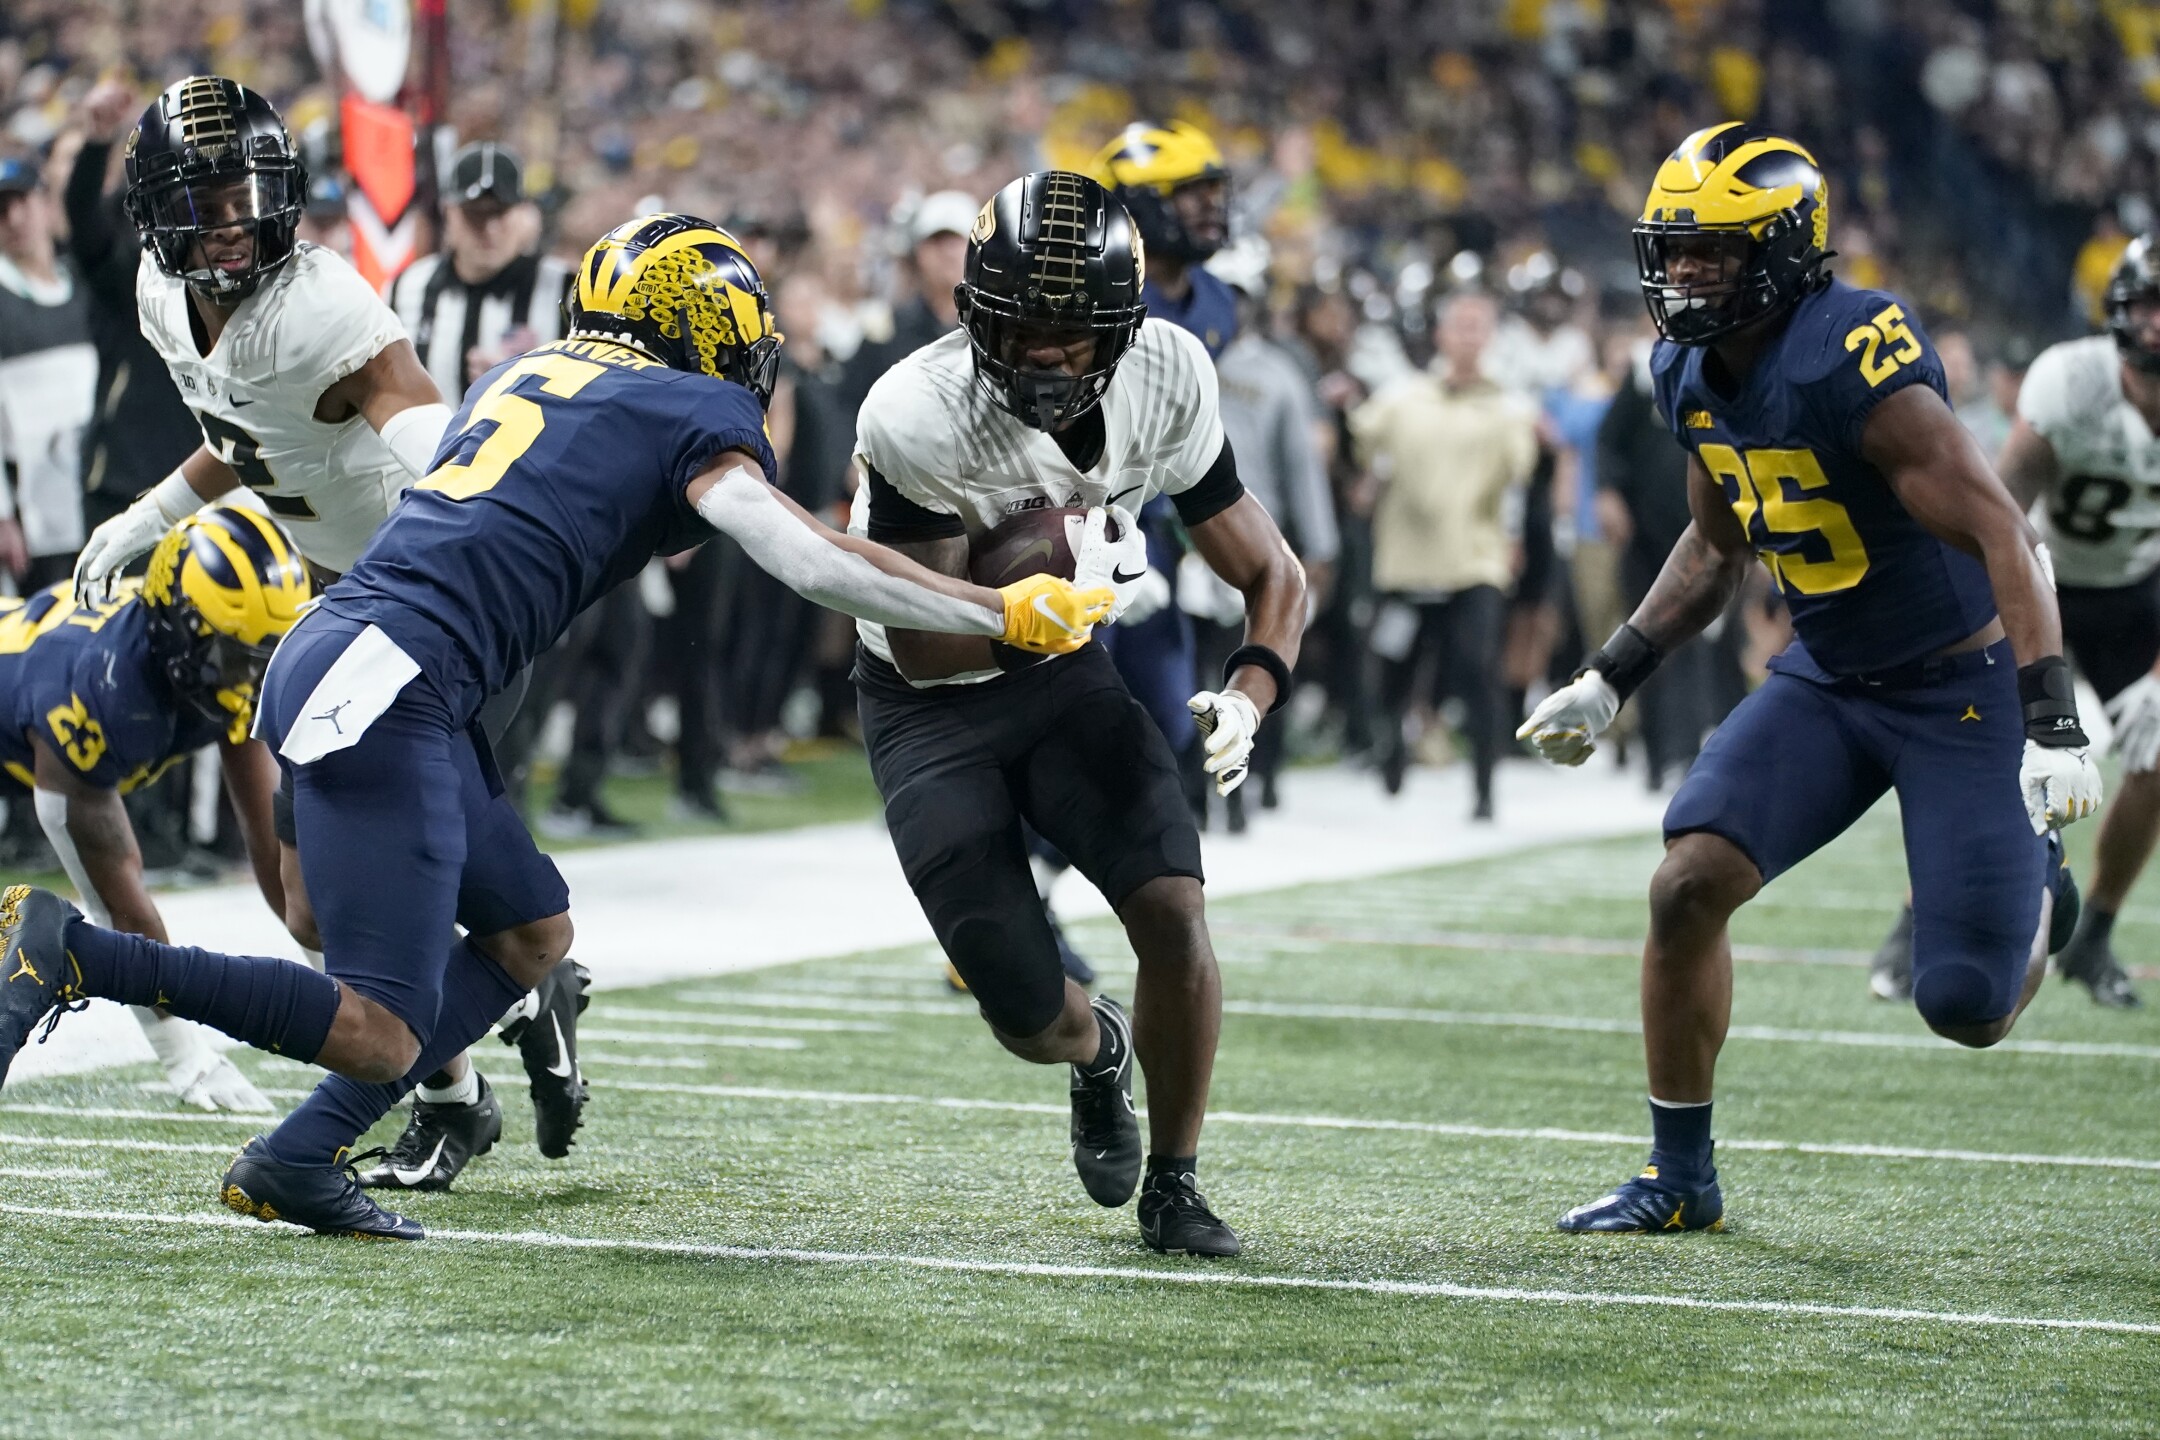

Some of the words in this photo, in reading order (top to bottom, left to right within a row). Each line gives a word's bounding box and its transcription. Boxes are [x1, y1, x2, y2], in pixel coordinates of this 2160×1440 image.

[1844, 303, 1922, 388] 25
[200, 411, 320, 521] 2
[414, 353, 608, 500] 5
[1698, 443, 1870, 596] 25
[47, 692, 106, 771] 23
